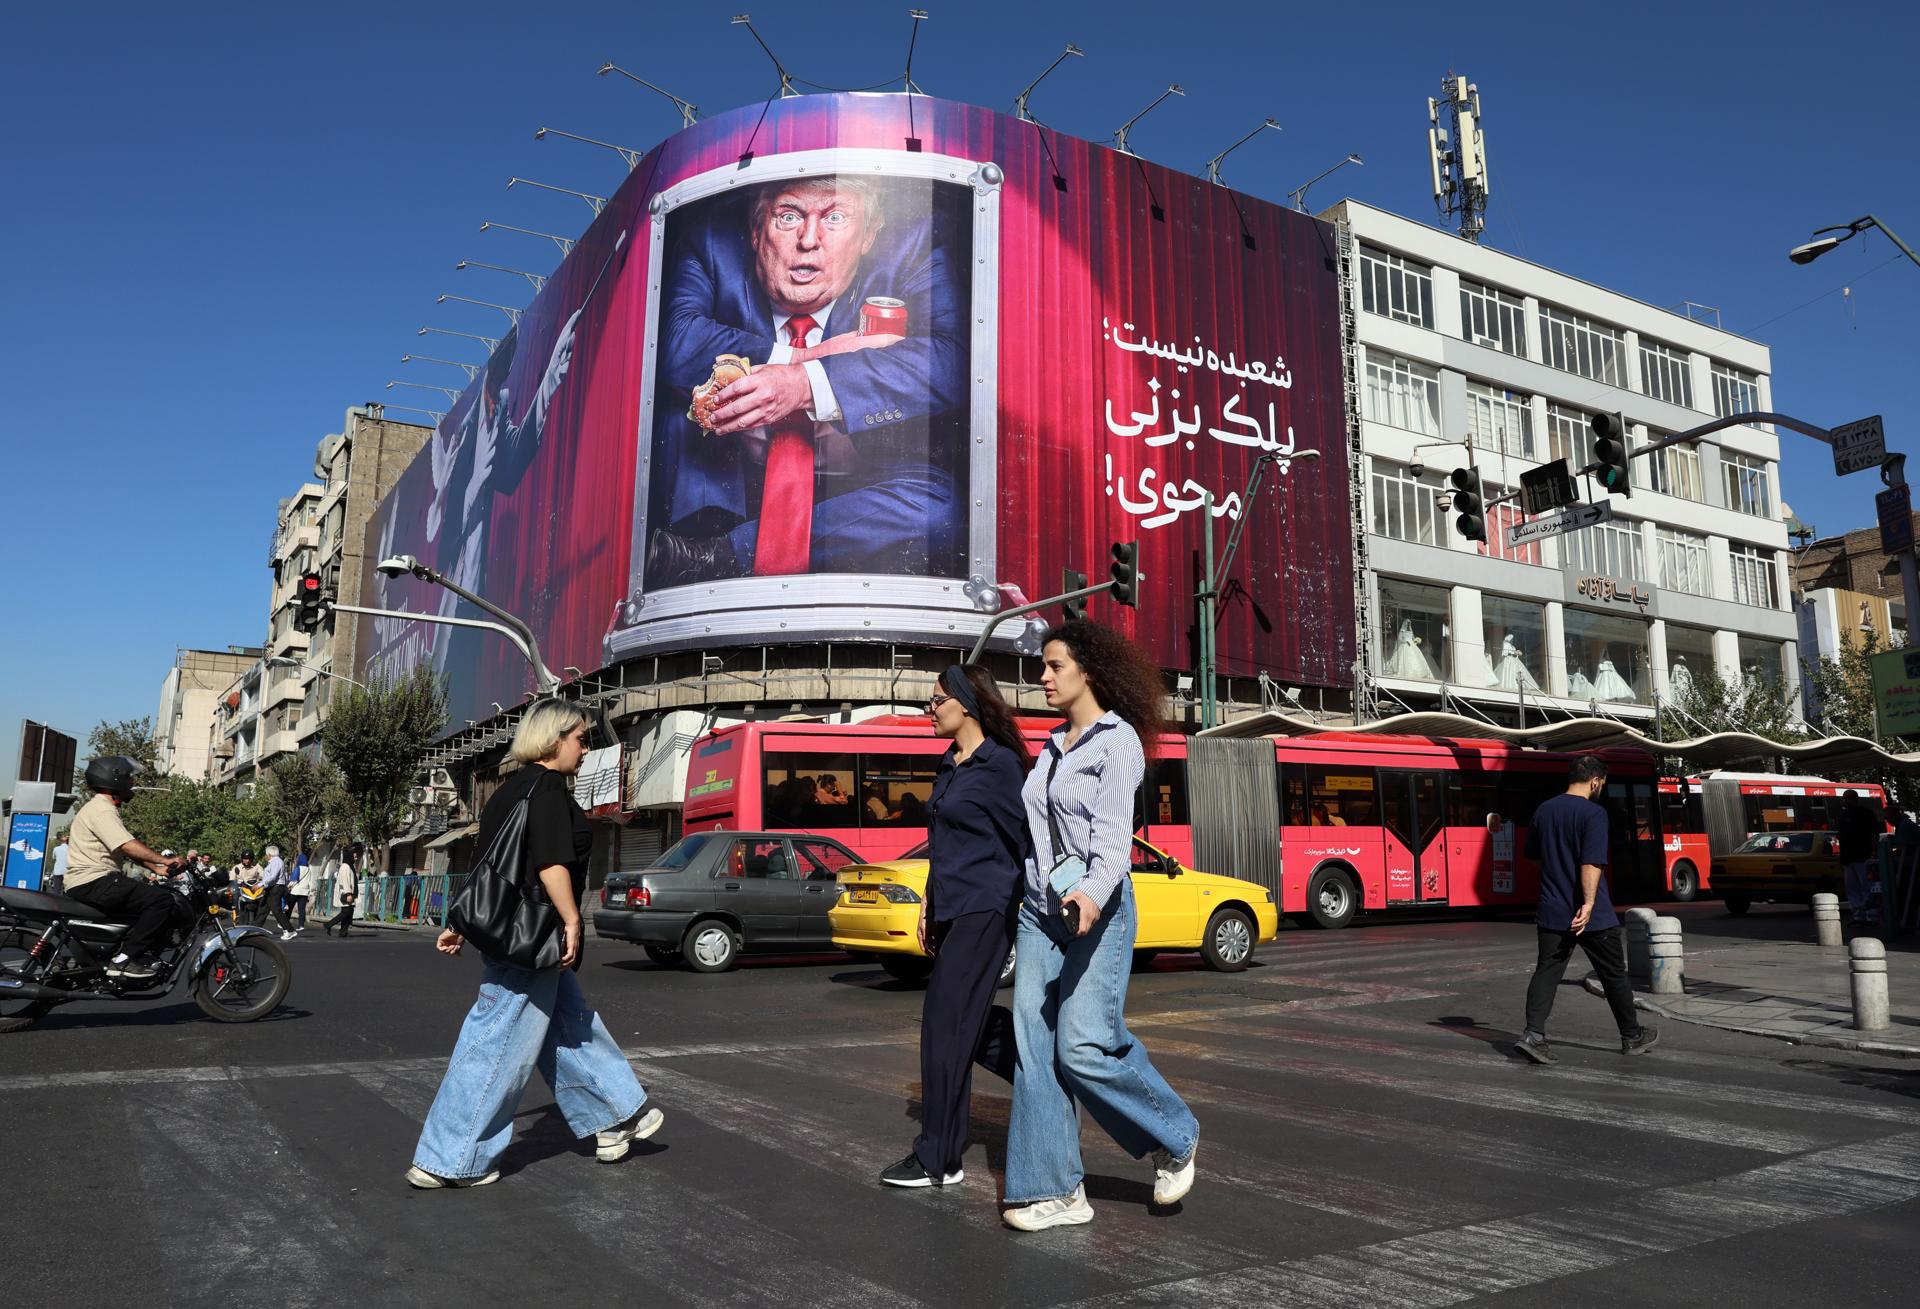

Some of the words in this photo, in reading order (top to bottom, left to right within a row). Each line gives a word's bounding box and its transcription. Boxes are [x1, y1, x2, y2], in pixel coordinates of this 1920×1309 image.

[1104, 316, 1204, 374] نیست!
[1207, 350, 1292, 389] شعبده
[1105, 376, 1201, 451] بزنی
[1209, 394, 1295, 475] پلک
[1105, 453, 1243, 529] محوی!
[1511, 525, 1539, 541] اسلامی
[1540, 519, 1572, 533] جمهوری
